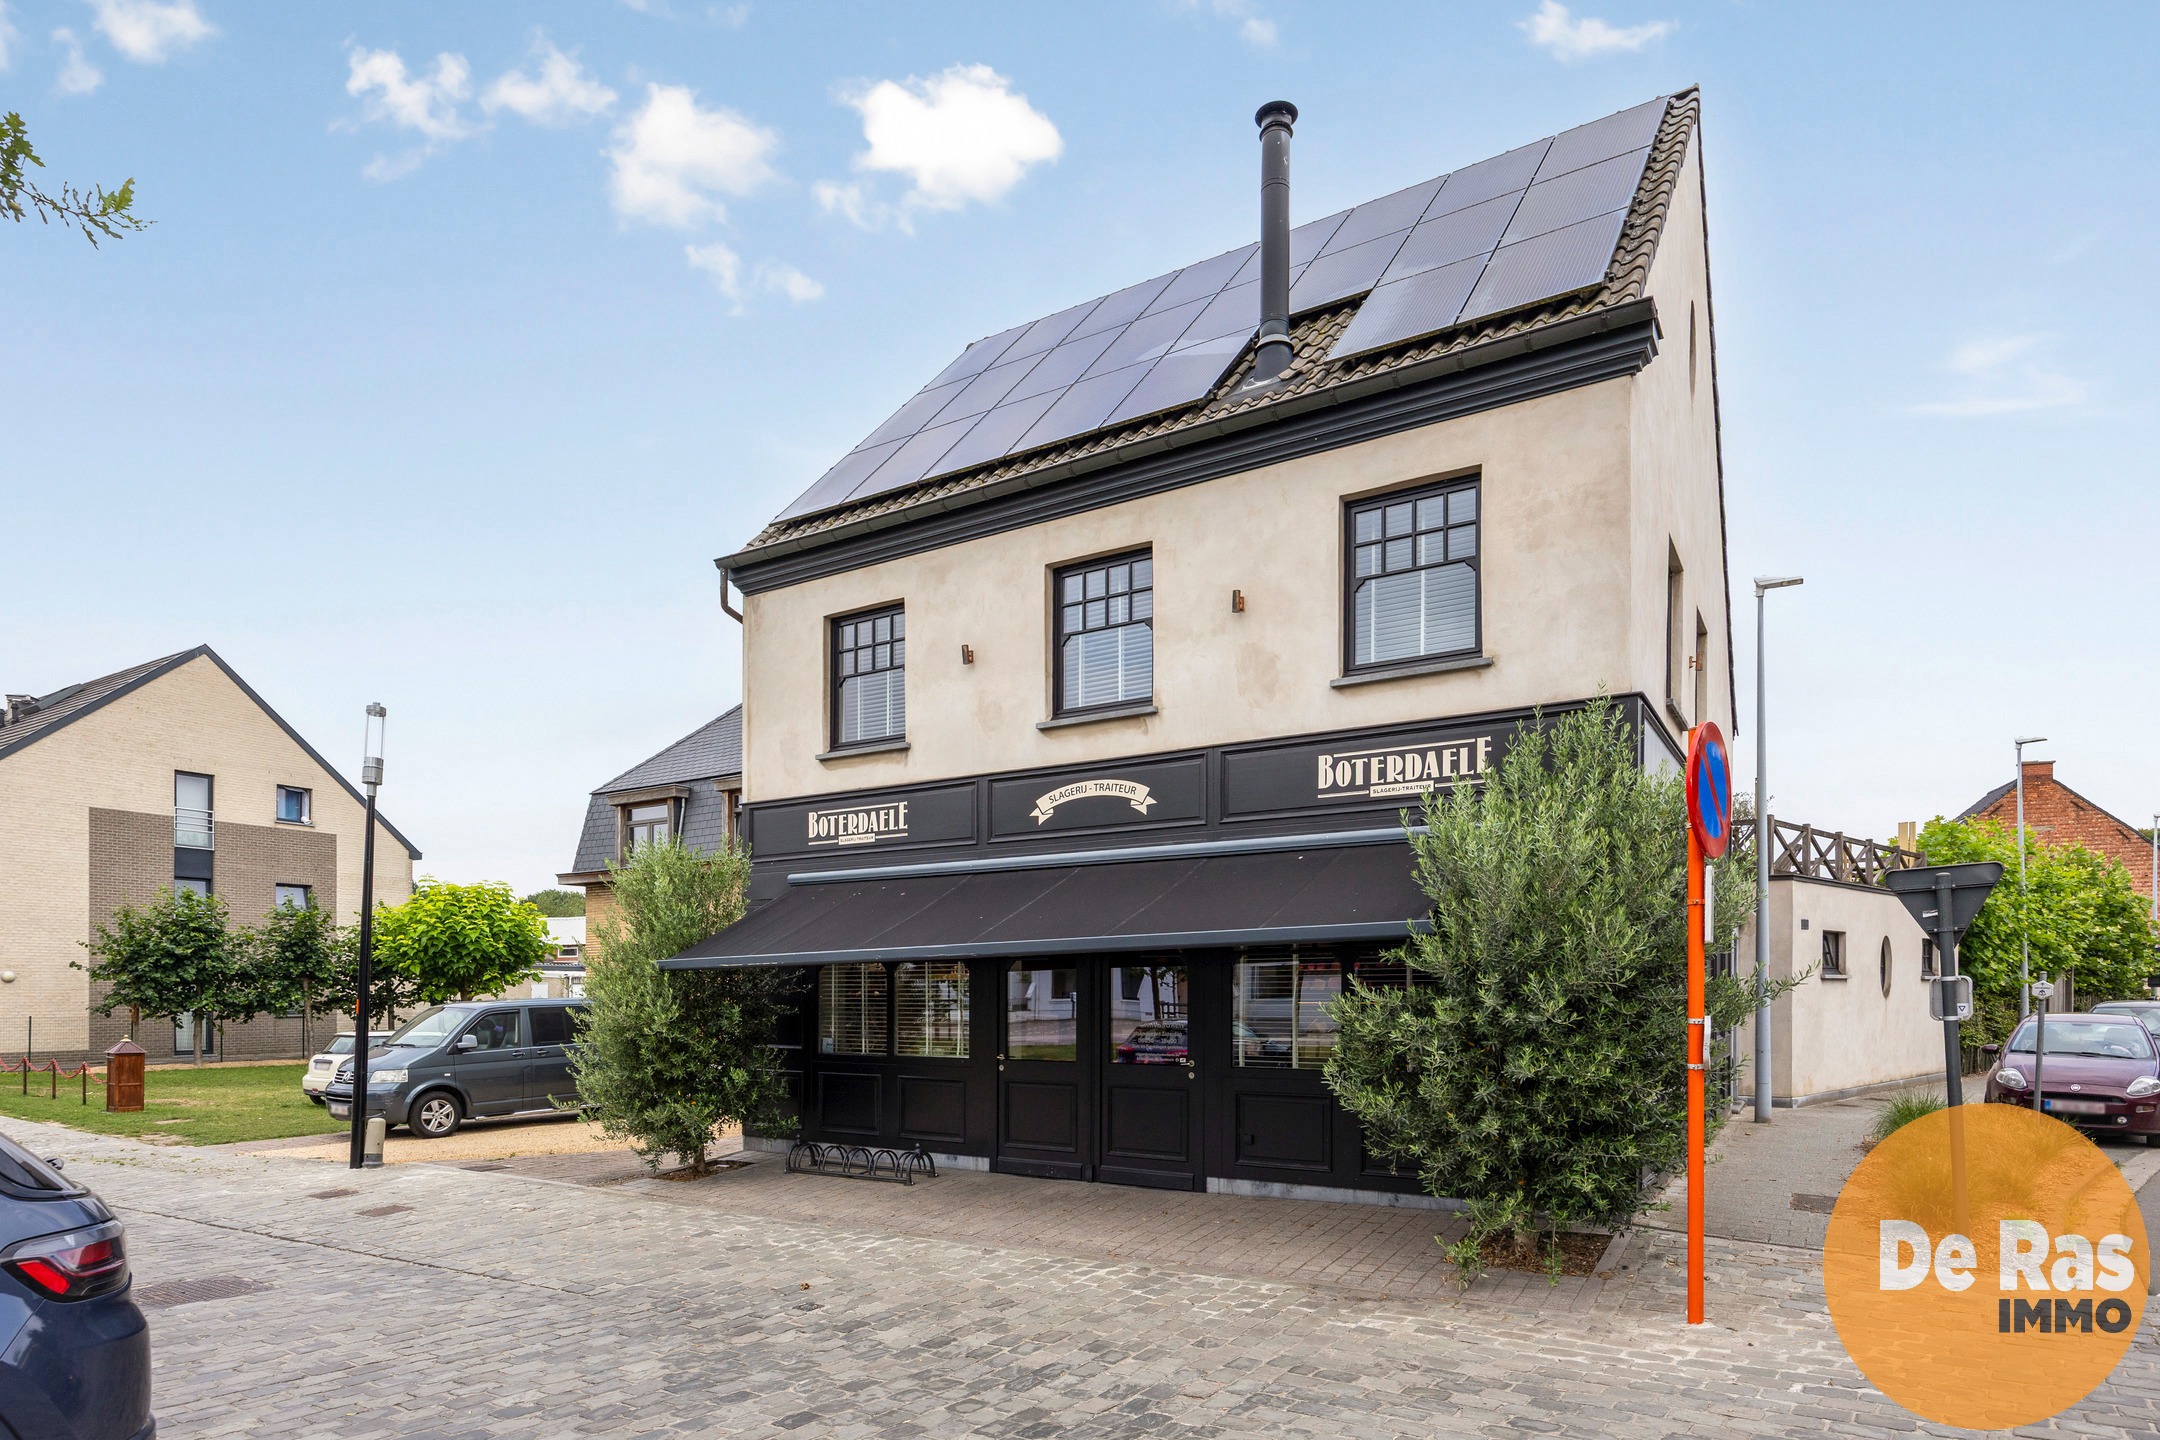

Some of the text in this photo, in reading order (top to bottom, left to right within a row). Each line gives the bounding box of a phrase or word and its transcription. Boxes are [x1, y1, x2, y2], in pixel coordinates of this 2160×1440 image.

[1317, 736, 1492, 790] BOTERDAELE
[1048, 785, 1087, 804] SLAGERIJ
[1094, 783, 1137, 796] TRAITEUR
[808, 801, 908, 838] BOTERDAELE
